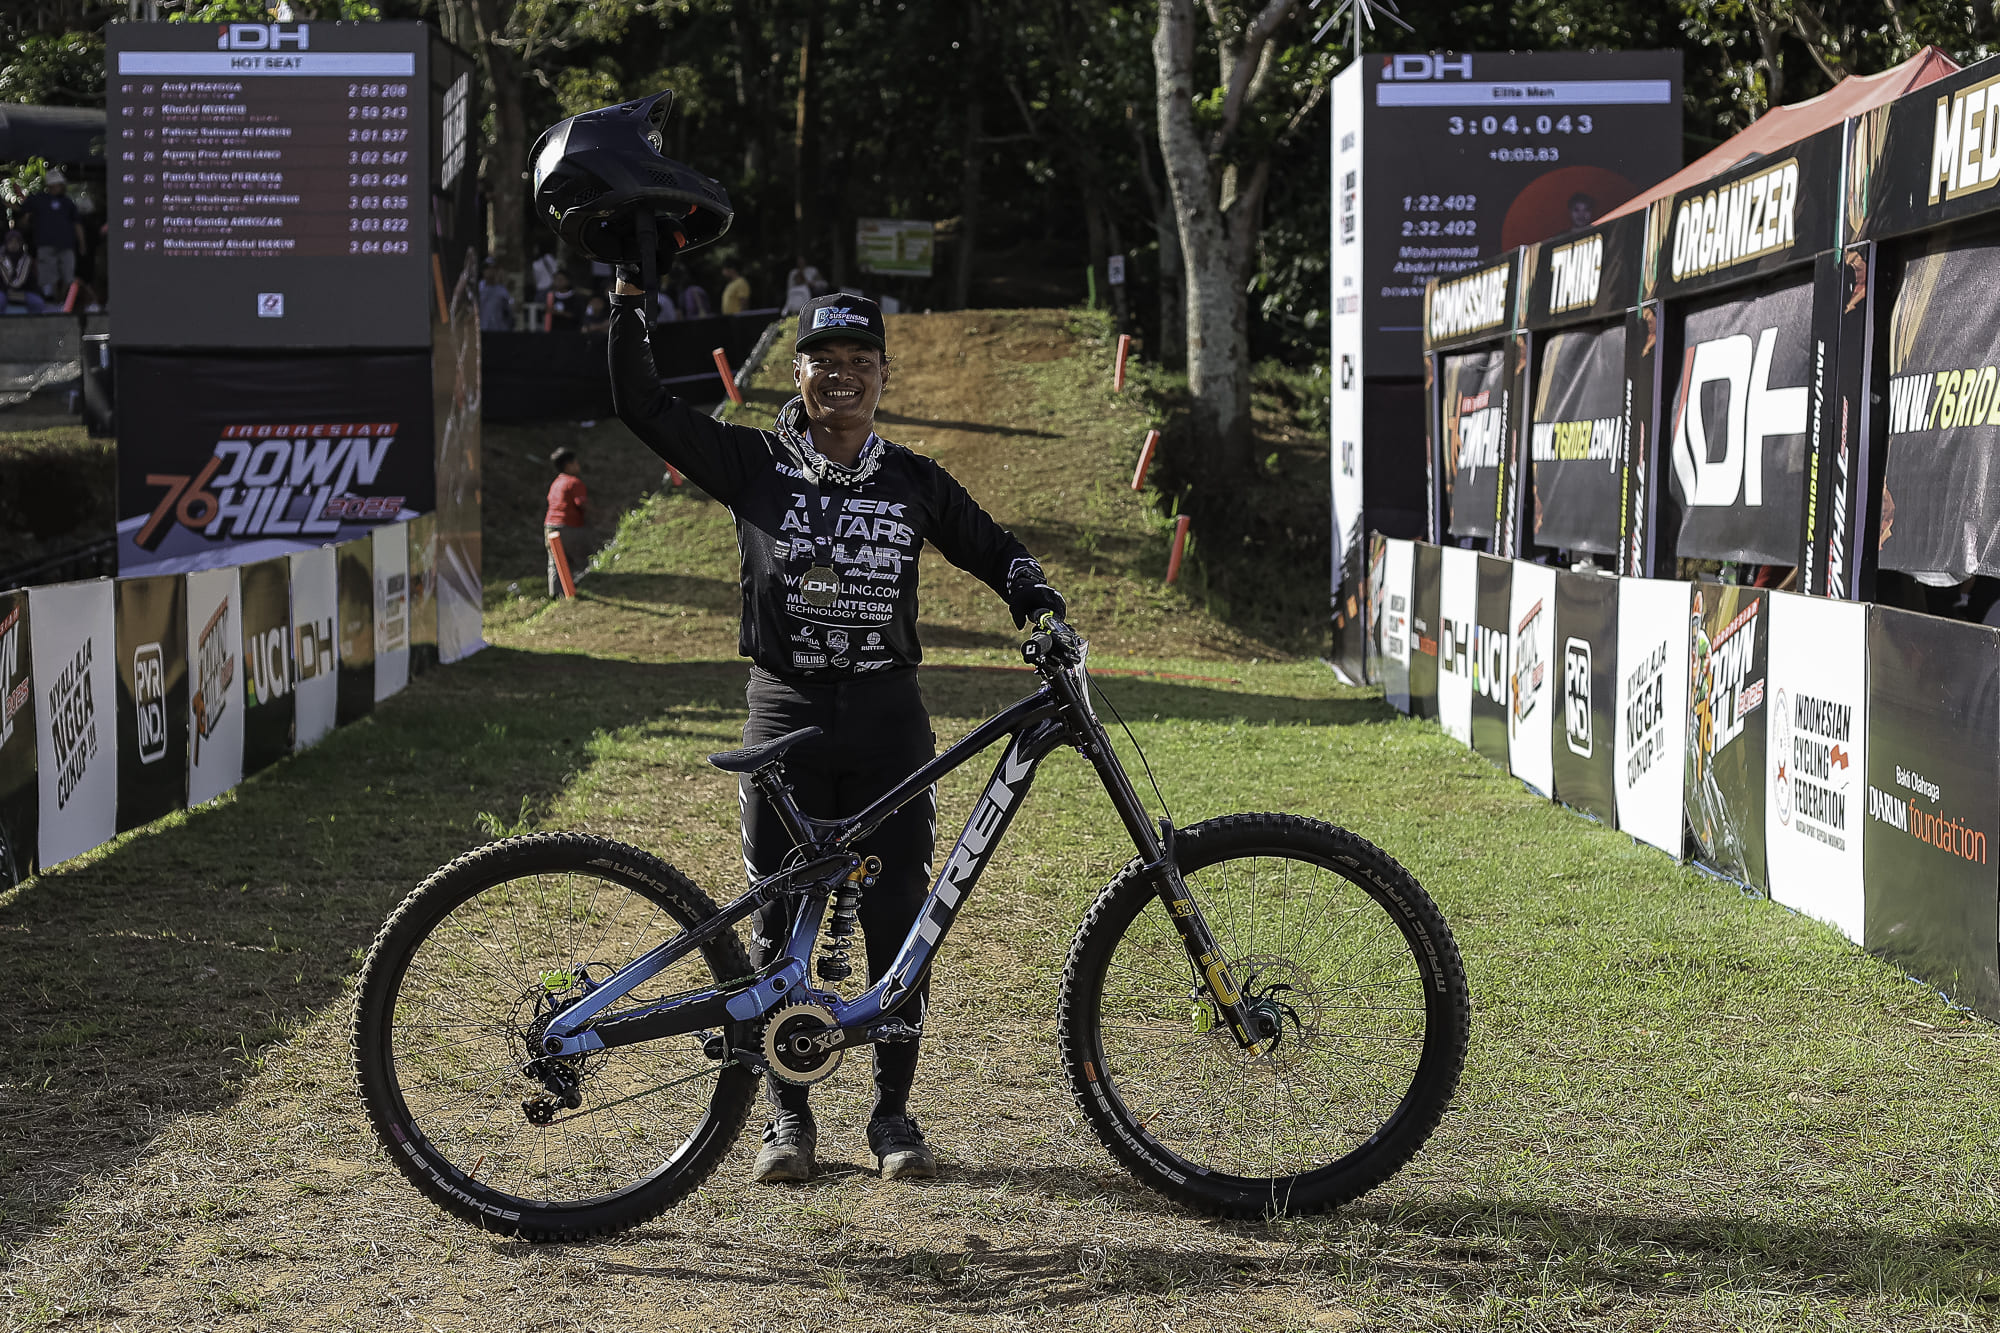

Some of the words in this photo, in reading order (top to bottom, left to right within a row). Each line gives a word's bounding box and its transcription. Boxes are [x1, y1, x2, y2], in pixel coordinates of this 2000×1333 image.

[231, 57, 261, 69] HOT
[264, 57, 303, 69] SEAT
[1492, 86, 1523, 98] Elite
[1527, 86, 1555, 98] Men
[1448, 114, 1594, 136] 3:04.043
[1401, 194, 1477, 212] 1:22.402
[1401, 220, 1477, 237] 2:32.402
[1671, 157, 1799, 283] ORGANIZER
[1549, 233, 1604, 316] TIMING
[828, 313, 869, 324] SUSPENSION
[1430, 262, 1511, 343] COMMISSAIRE
[224, 424, 396, 438] INDONESIAN
[210, 437, 395, 498] DOWN
[132, 455, 223, 550] 76
[204, 486, 342, 536] HILL
[785, 603, 857, 619] TECHNOLOGY
[859, 612, 893, 622] GROUP
[75, 635, 92, 679] AJA
[137, 658, 161, 702] PVR
[251, 625, 289, 705] UCI
[795, 652, 826, 664] ÖHLINS
[1477, 625, 1508, 706] UCI
[1710, 614, 1758, 705] DOWN
[51, 668, 94, 773] NGGA
[1627, 672, 1664, 752] NGGA
[1794, 692, 1851, 743] INDONESIAN
[57, 740, 86, 811] CUKUP
[1627, 737, 1653, 789] CUKUP
[1793, 735, 1829, 782] CYCLING
[1794, 777, 1846, 831] FEDERATION
[1911, 771, 1940, 804] Olahraga
[908, 742, 1035, 947] TREK
[1868, 785, 1909, 833] DJARUM
[1908, 797, 1987, 865] foundation
[1090, 1081, 1187, 1185] SCHWALBE
[401, 1141, 521, 1221] SCHWALBE
